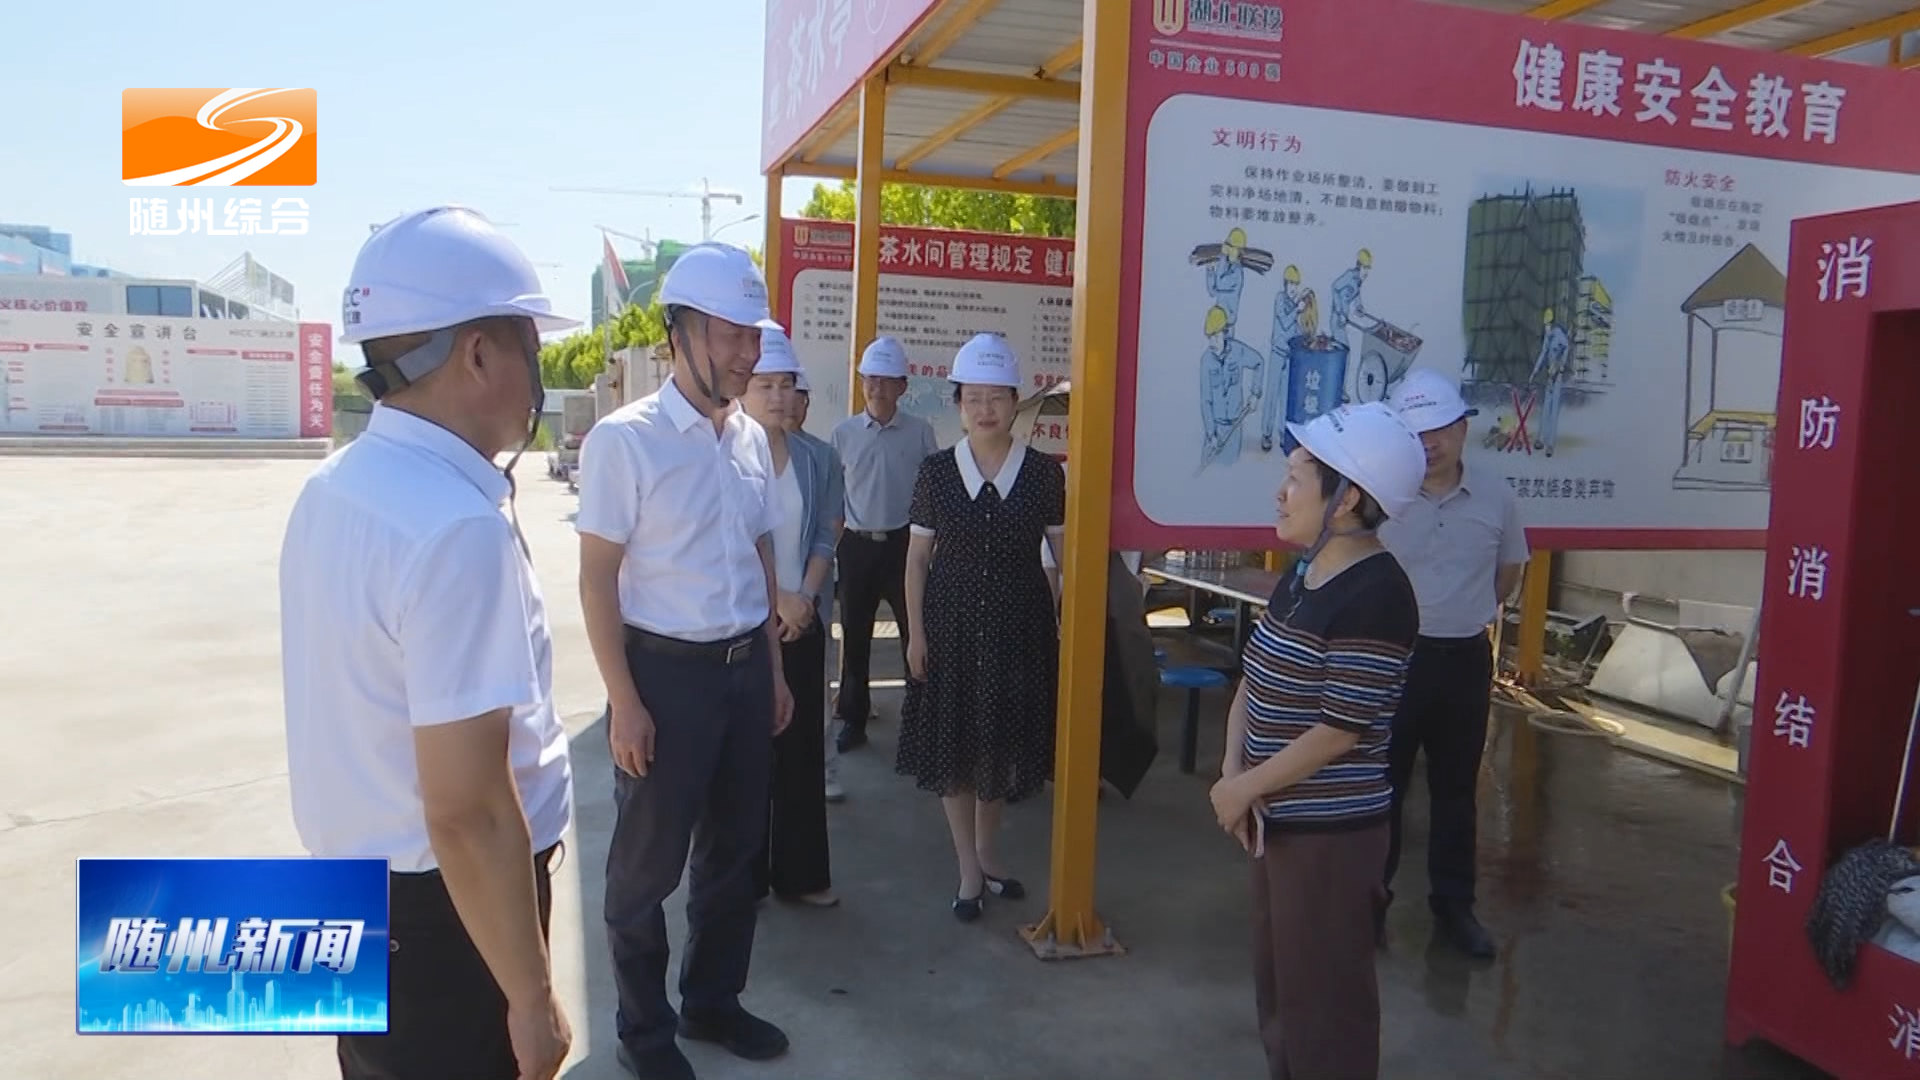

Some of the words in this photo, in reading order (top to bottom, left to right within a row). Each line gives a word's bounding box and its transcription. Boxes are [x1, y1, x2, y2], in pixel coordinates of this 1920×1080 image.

[1149, 50, 1281, 81] 中国企业500强
[1513, 38, 1846, 144] 健康安全教育
[1210, 128, 1303, 154] 文明行为
[1664, 169, 1736, 192] 防火安全
[879, 236, 1033, 274] 茶水间管理规定
[76, 321, 197, 341] 安全宣讲台
[1032, 423, 1069, 440] 不良
